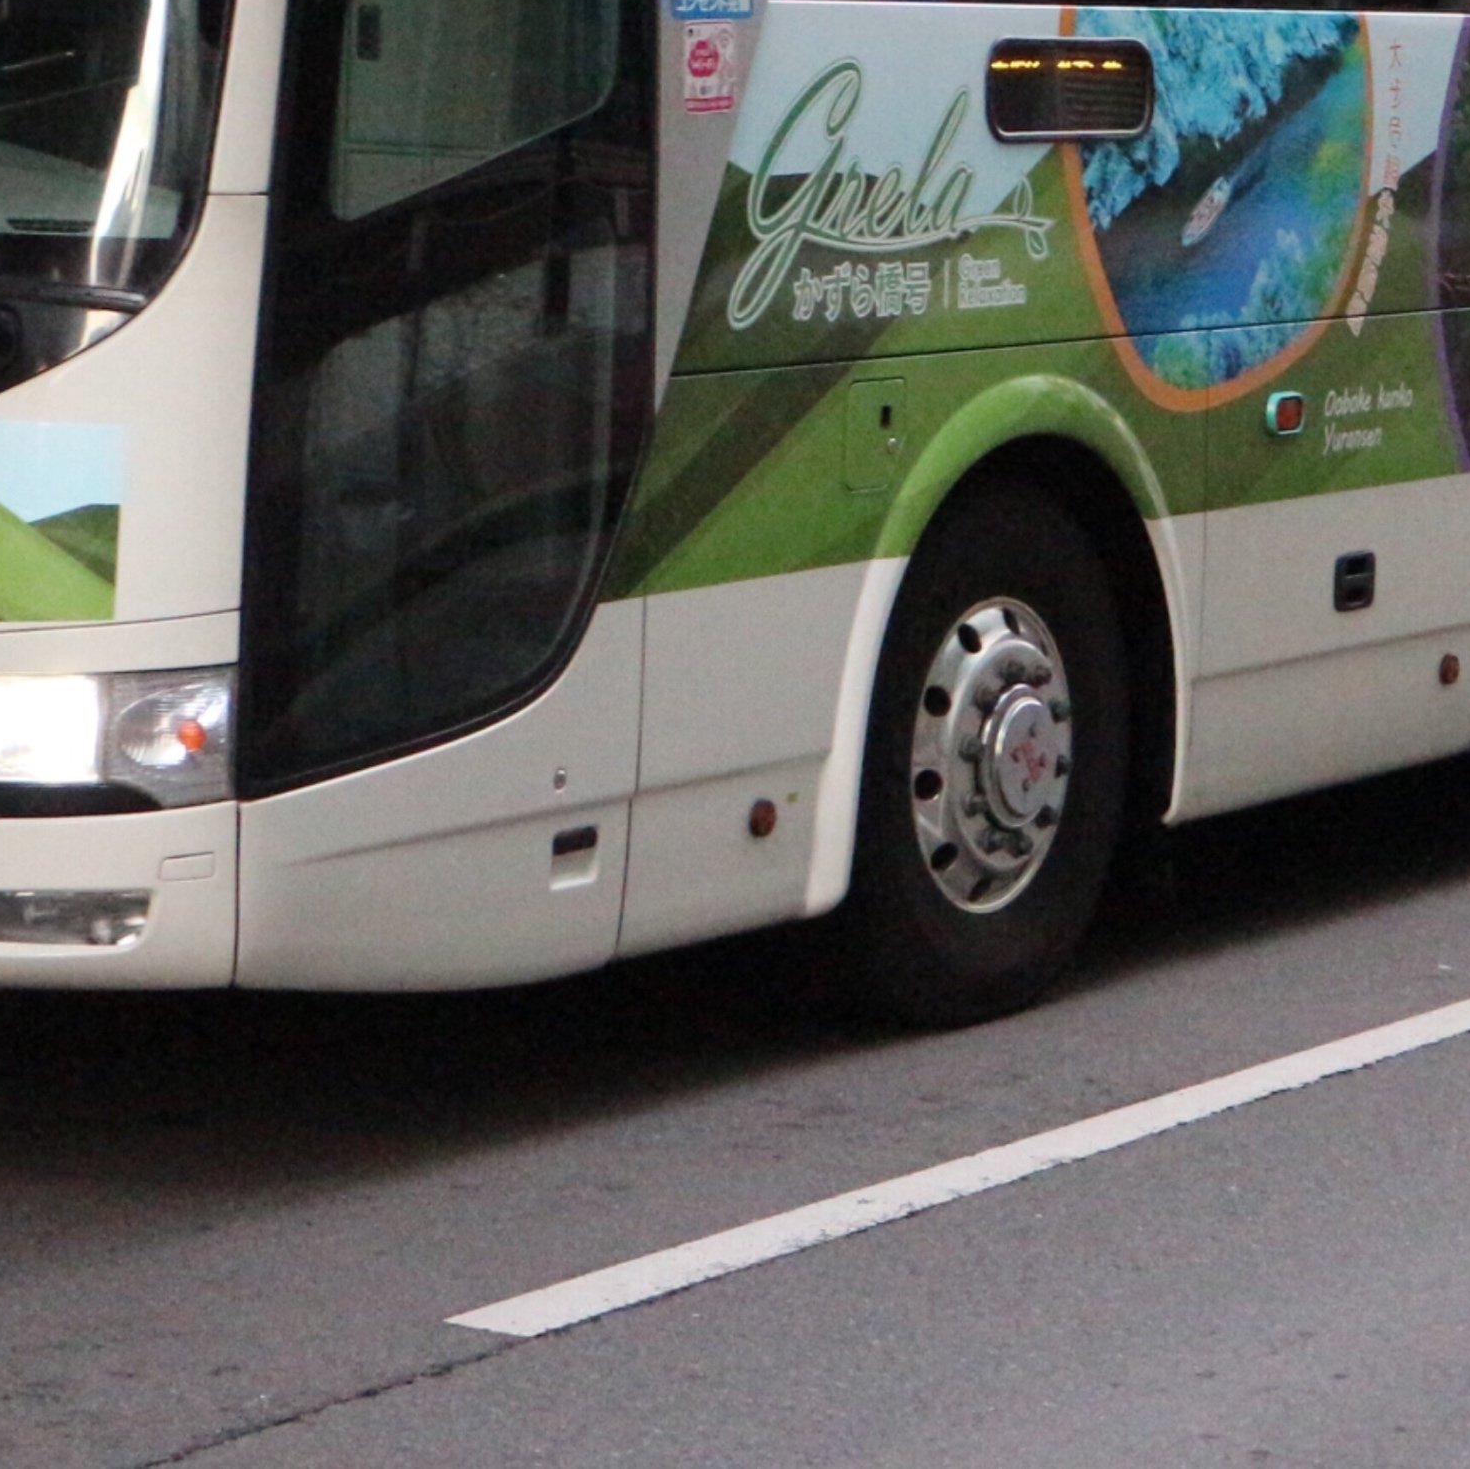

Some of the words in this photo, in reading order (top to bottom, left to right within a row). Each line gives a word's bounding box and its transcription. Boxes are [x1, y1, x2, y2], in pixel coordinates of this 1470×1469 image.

[792, 261, 933, 321] かずら橋号
